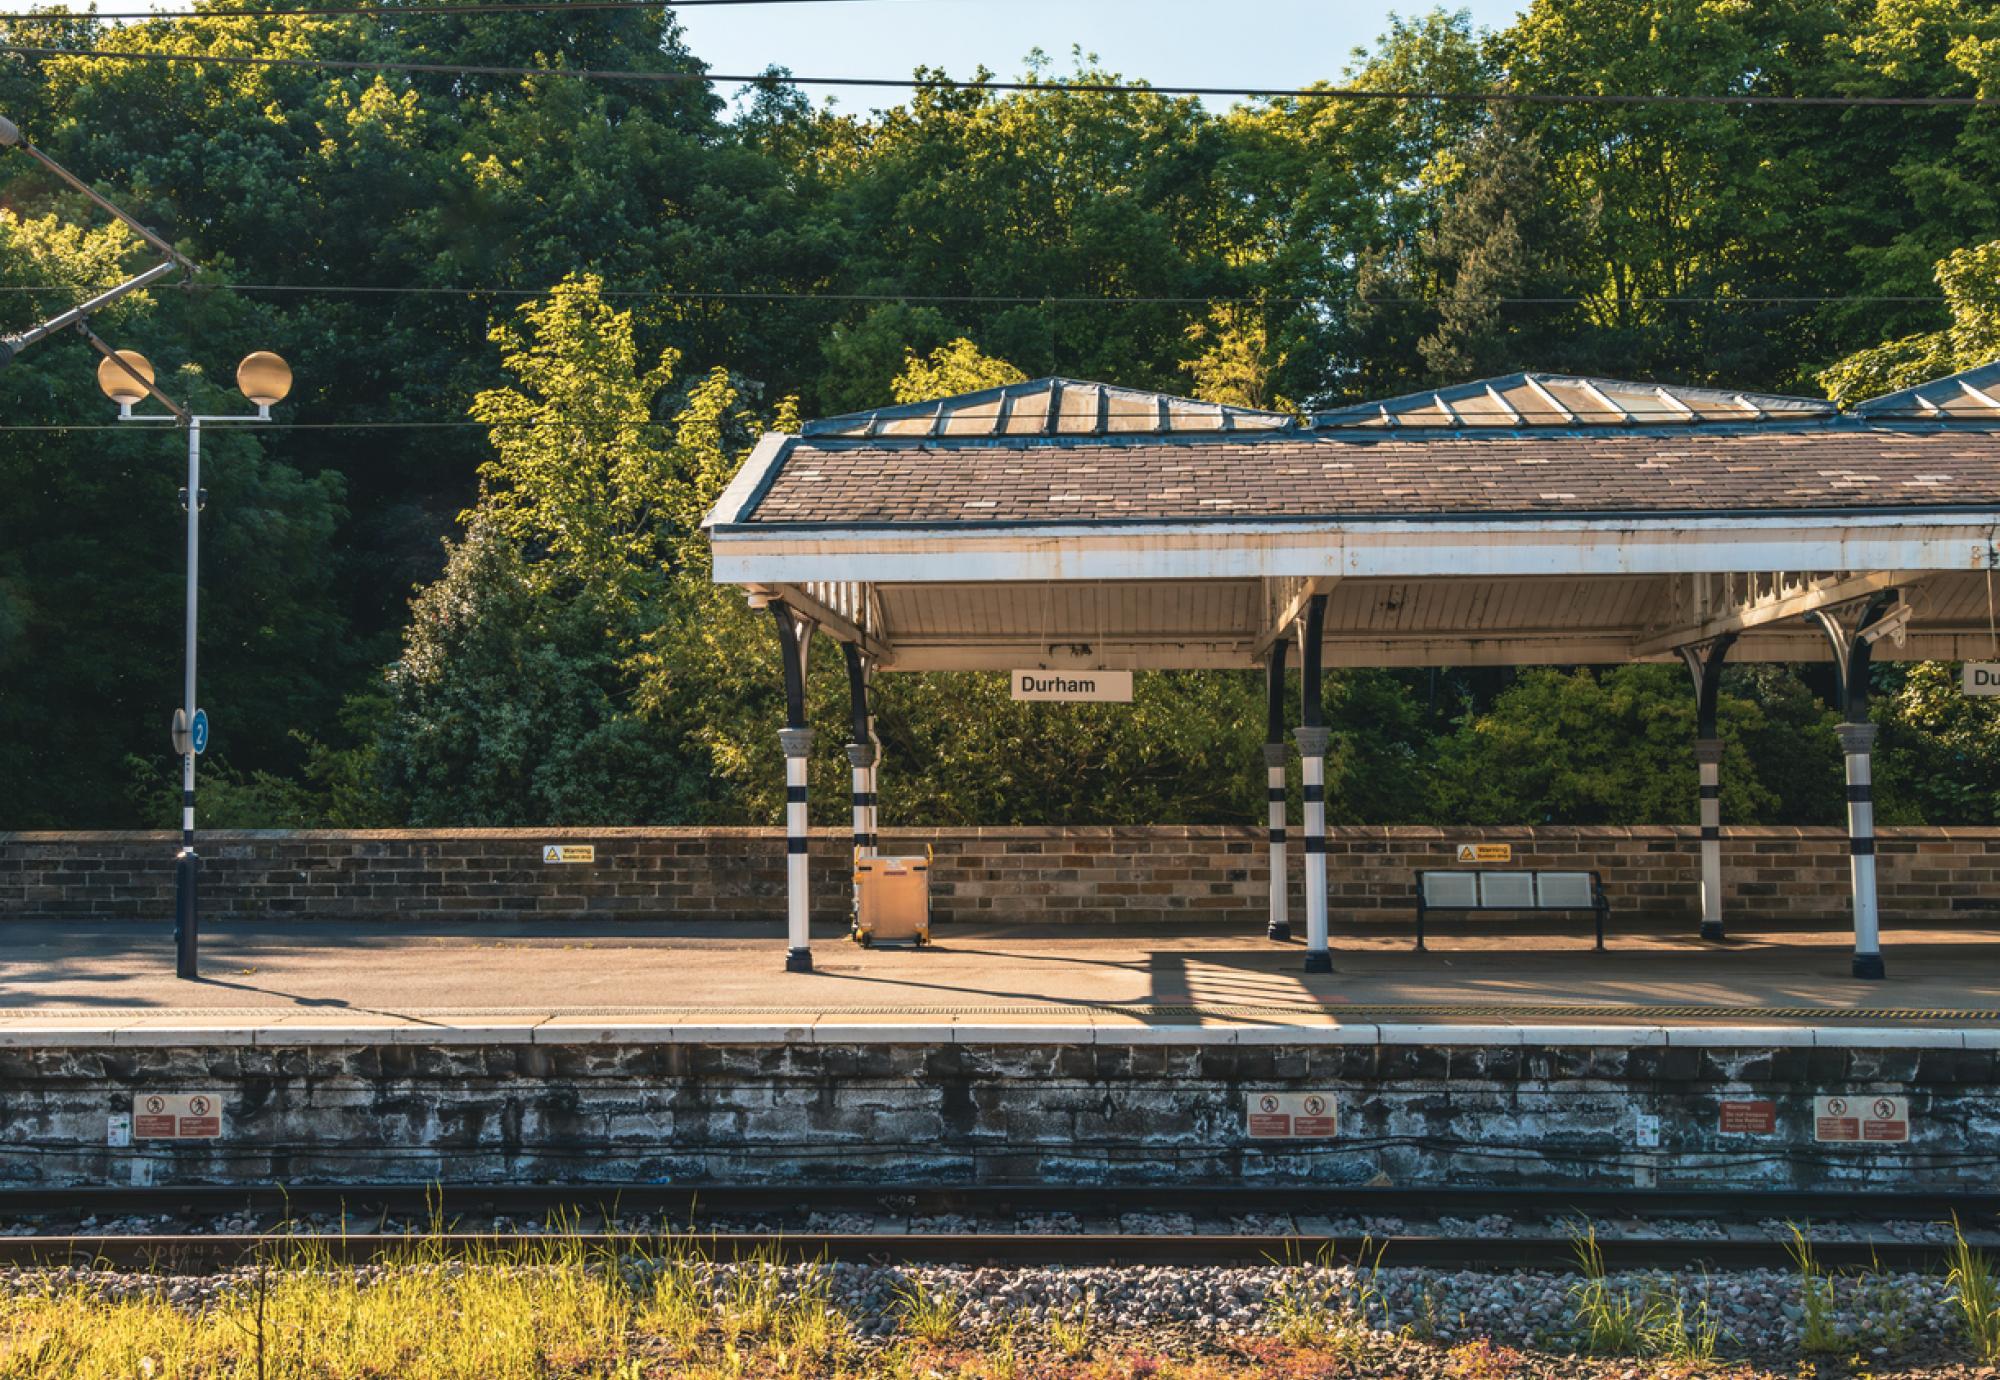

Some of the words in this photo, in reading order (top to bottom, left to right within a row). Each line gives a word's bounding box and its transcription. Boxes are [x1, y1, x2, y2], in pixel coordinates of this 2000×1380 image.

[1021, 676, 1096, 692] Durham
[1975, 670, 2000, 685] Du
[196, 724, 204, 745] 2
